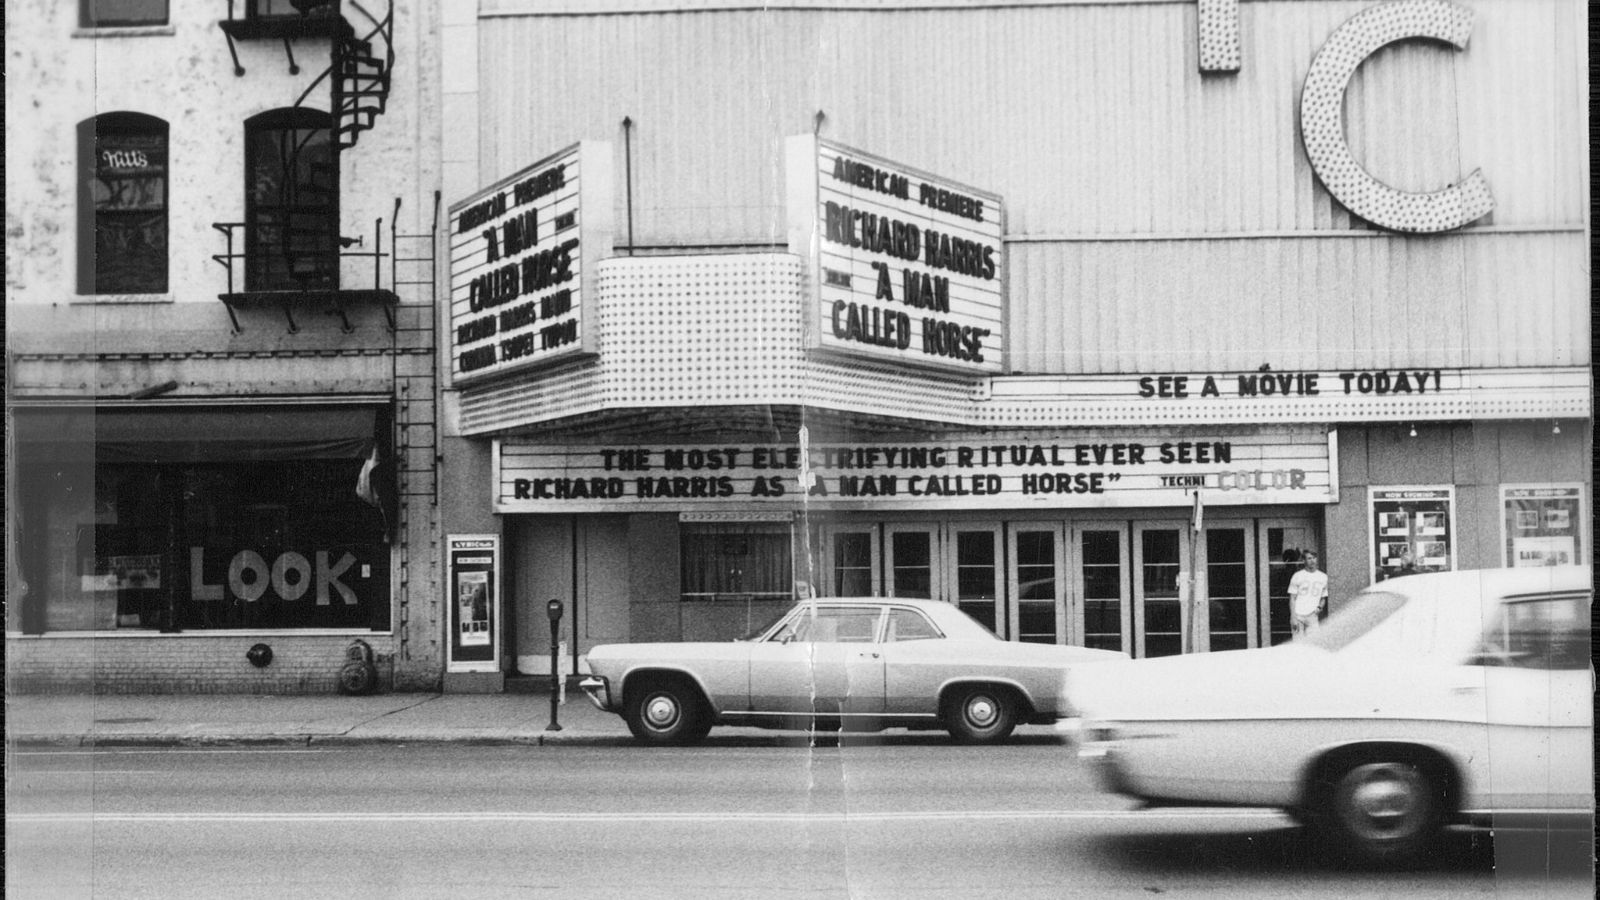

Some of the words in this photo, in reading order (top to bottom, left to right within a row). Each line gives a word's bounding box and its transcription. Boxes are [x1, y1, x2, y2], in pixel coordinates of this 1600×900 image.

[458, 191, 506, 234] AMERICAN
[514, 163, 566, 207] PREMIERE
[833, 156, 909, 200] AMERICAN
[919, 183, 984, 222] PREMIERE
[503, 207, 538, 258] MAN
[825, 200, 921, 261] RICHARD
[924, 229, 995, 280] HARRIS
[469, 262, 520, 313] CALLED
[903, 268, 950, 313] MAN
[500, 301, 536, 333] HARRIS
[832, 299, 911, 350] CALLED
[1139, 376, 1189, 398] SEE
[1200, 376, 1220, 397] A
[1238, 373, 1319, 397] MOVIE
[1339, 369, 1441, 395] TODAY!
[602, 449, 651, 471] THE
[664, 448, 740, 470] MOST
[957, 445, 1065, 468] RITUAL
[1075, 443, 1146, 466] EVER
[1159, 442, 1232, 464] SEEN
[514, 478, 624, 499] RICHARD
[636, 475, 735, 498] HARRIS
[750, 475, 786, 497] AS
[839, 475, 897, 497] MAN
[908, 473, 1003, 496] CALLED
[1160, 475, 1206, 488] TECHNI
[1217, 469, 1307, 491] COLOR
[190, 547, 357, 605] LOOK
